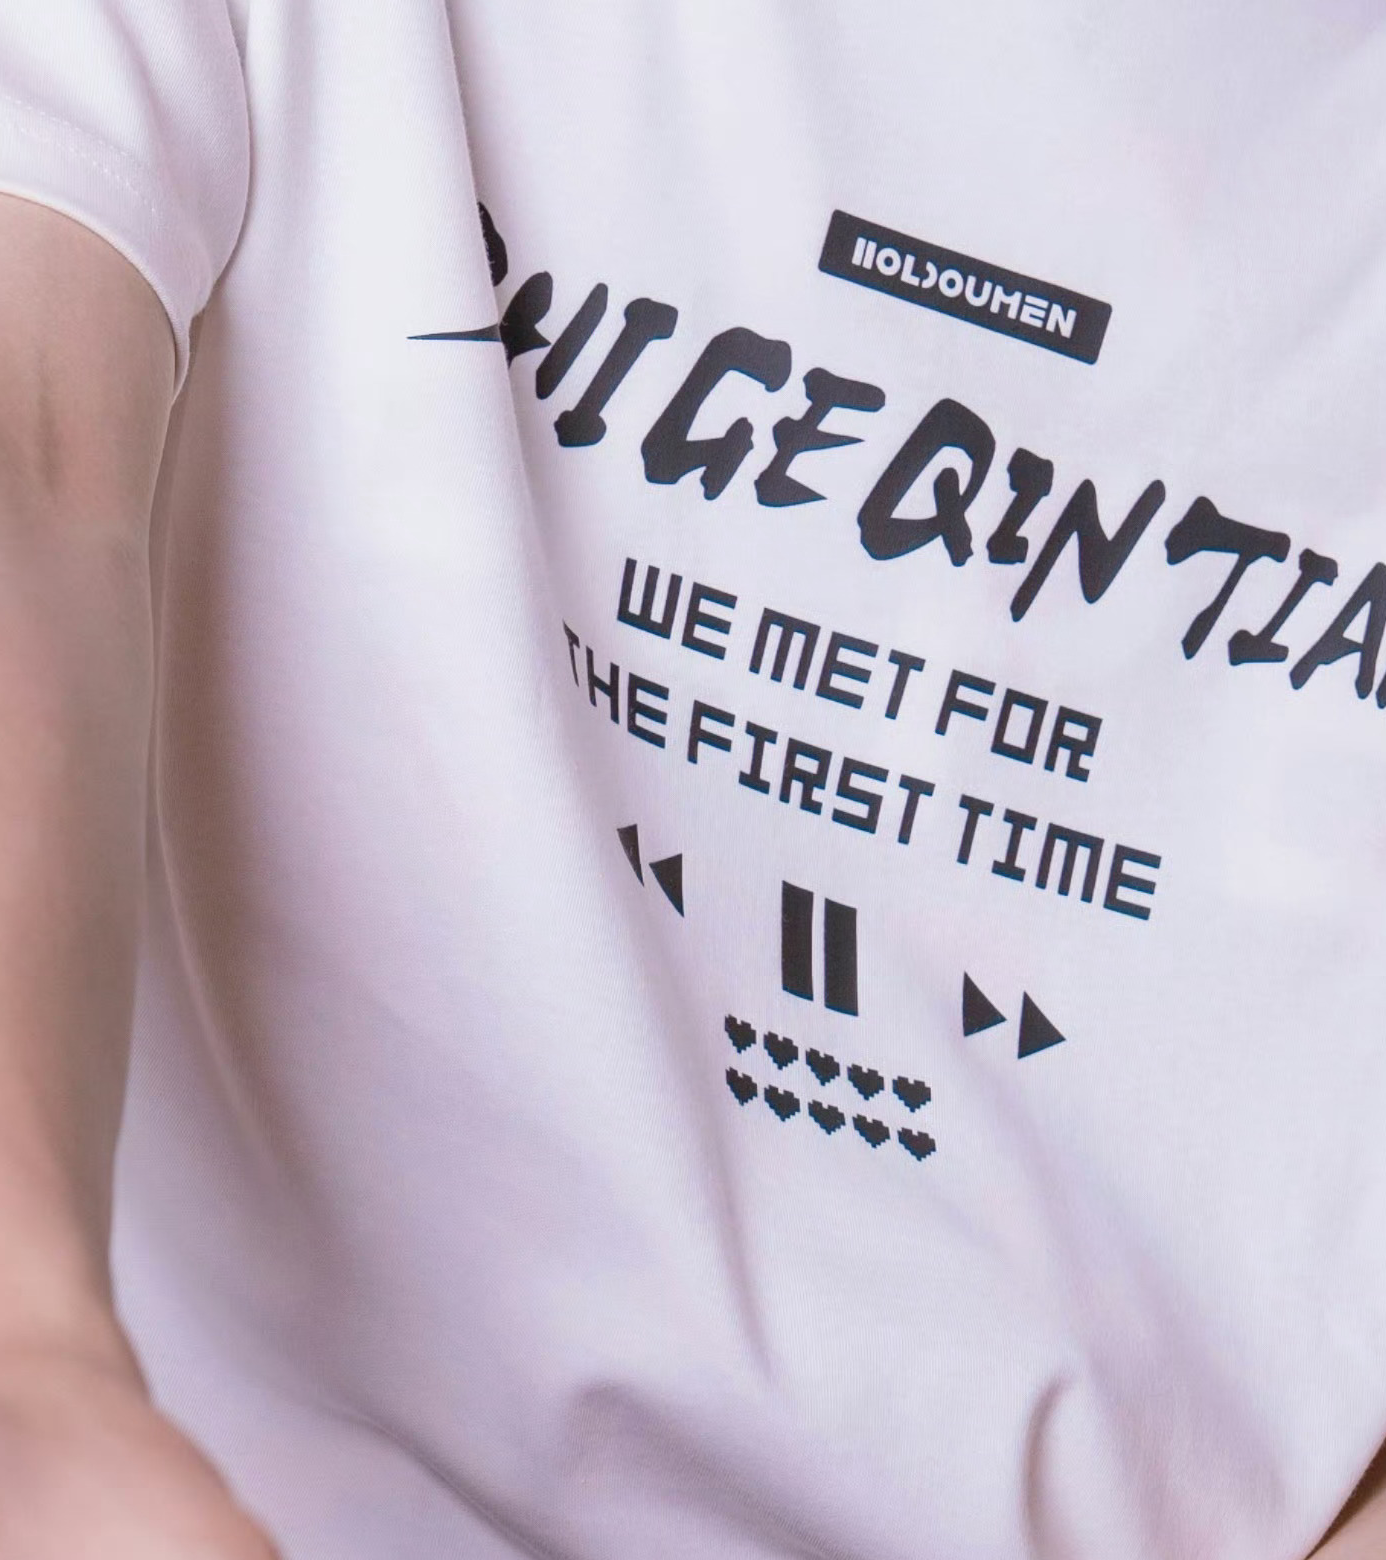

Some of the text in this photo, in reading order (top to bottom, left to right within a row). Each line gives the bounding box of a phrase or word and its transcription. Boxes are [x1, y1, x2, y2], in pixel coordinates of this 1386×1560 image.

[562, 619, 1162, 921] THE FIRST TIME
[616, 557, 1103, 783] WE MET FOR
